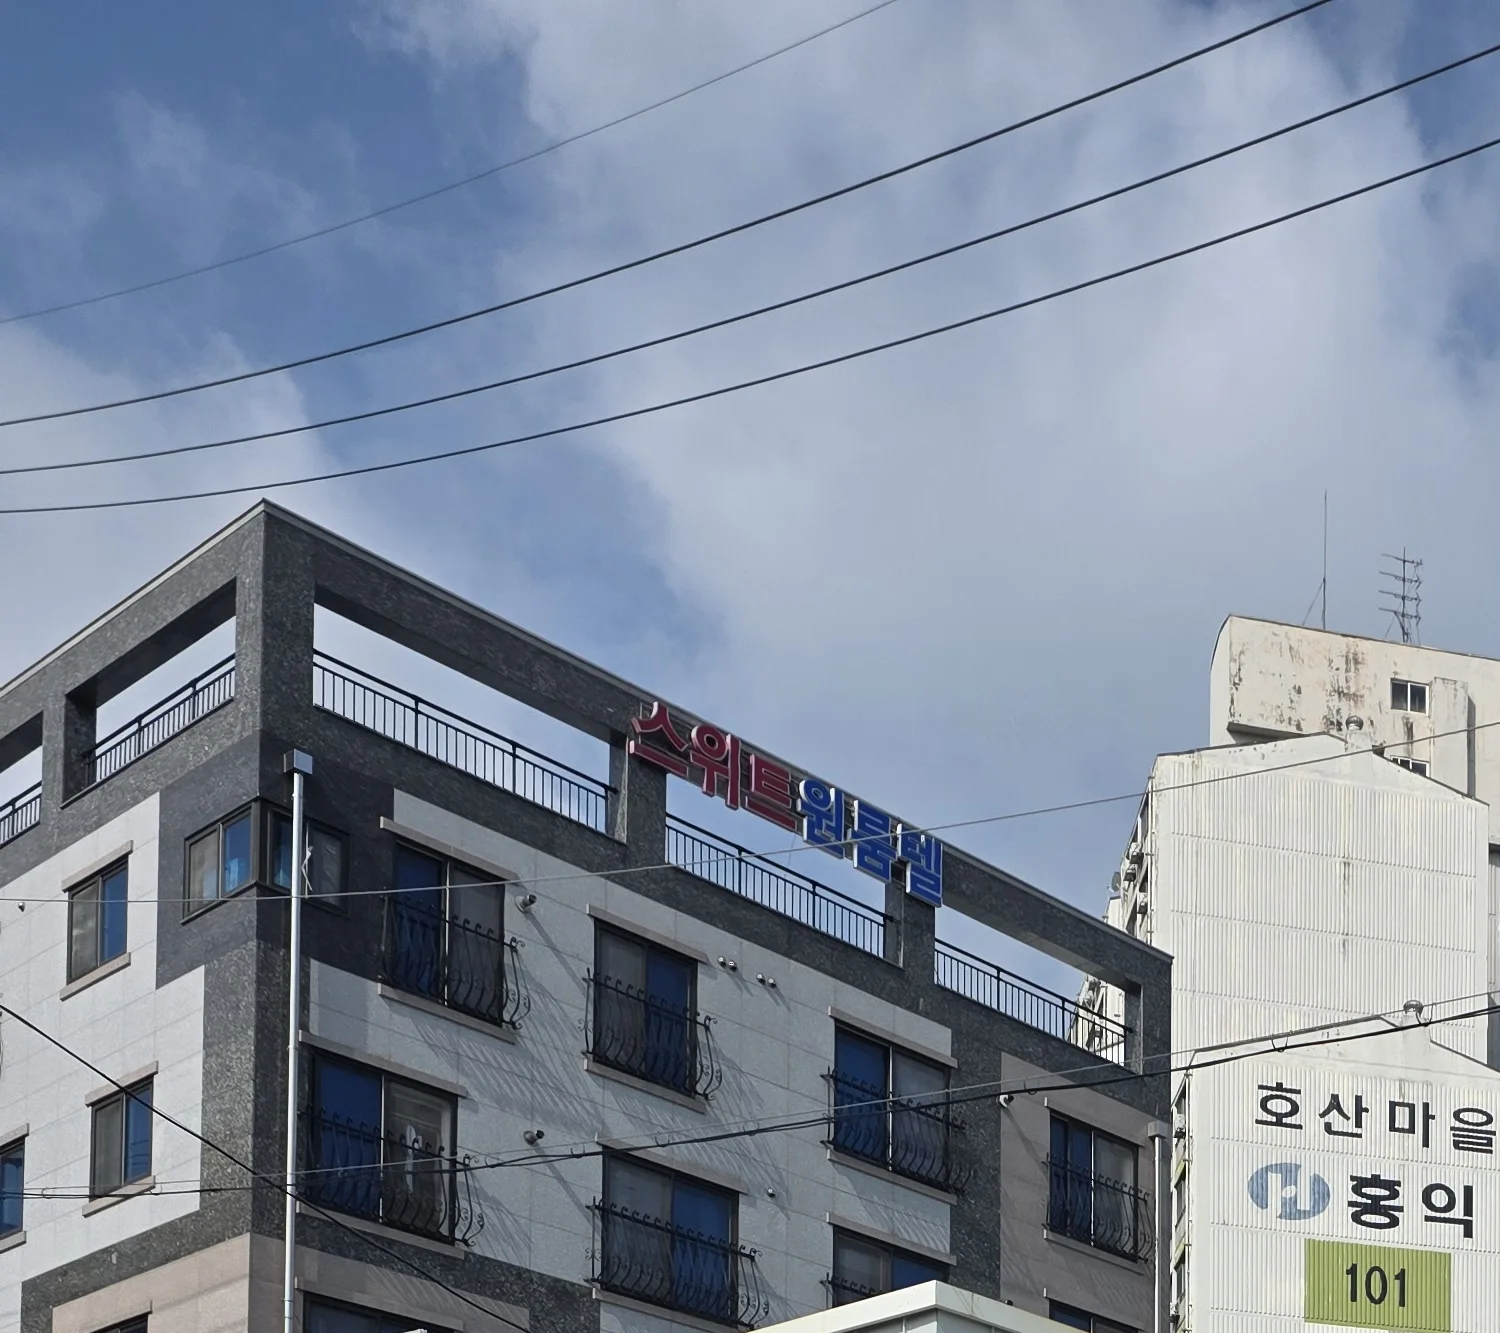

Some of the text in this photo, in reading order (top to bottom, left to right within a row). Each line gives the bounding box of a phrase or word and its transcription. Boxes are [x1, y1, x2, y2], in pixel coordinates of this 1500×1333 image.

[1254, 1081, 1497, 1155] 호산마을
[1347, 1173, 1474, 1239] 홍익
[1345, 1262, 1406, 1308] 101
